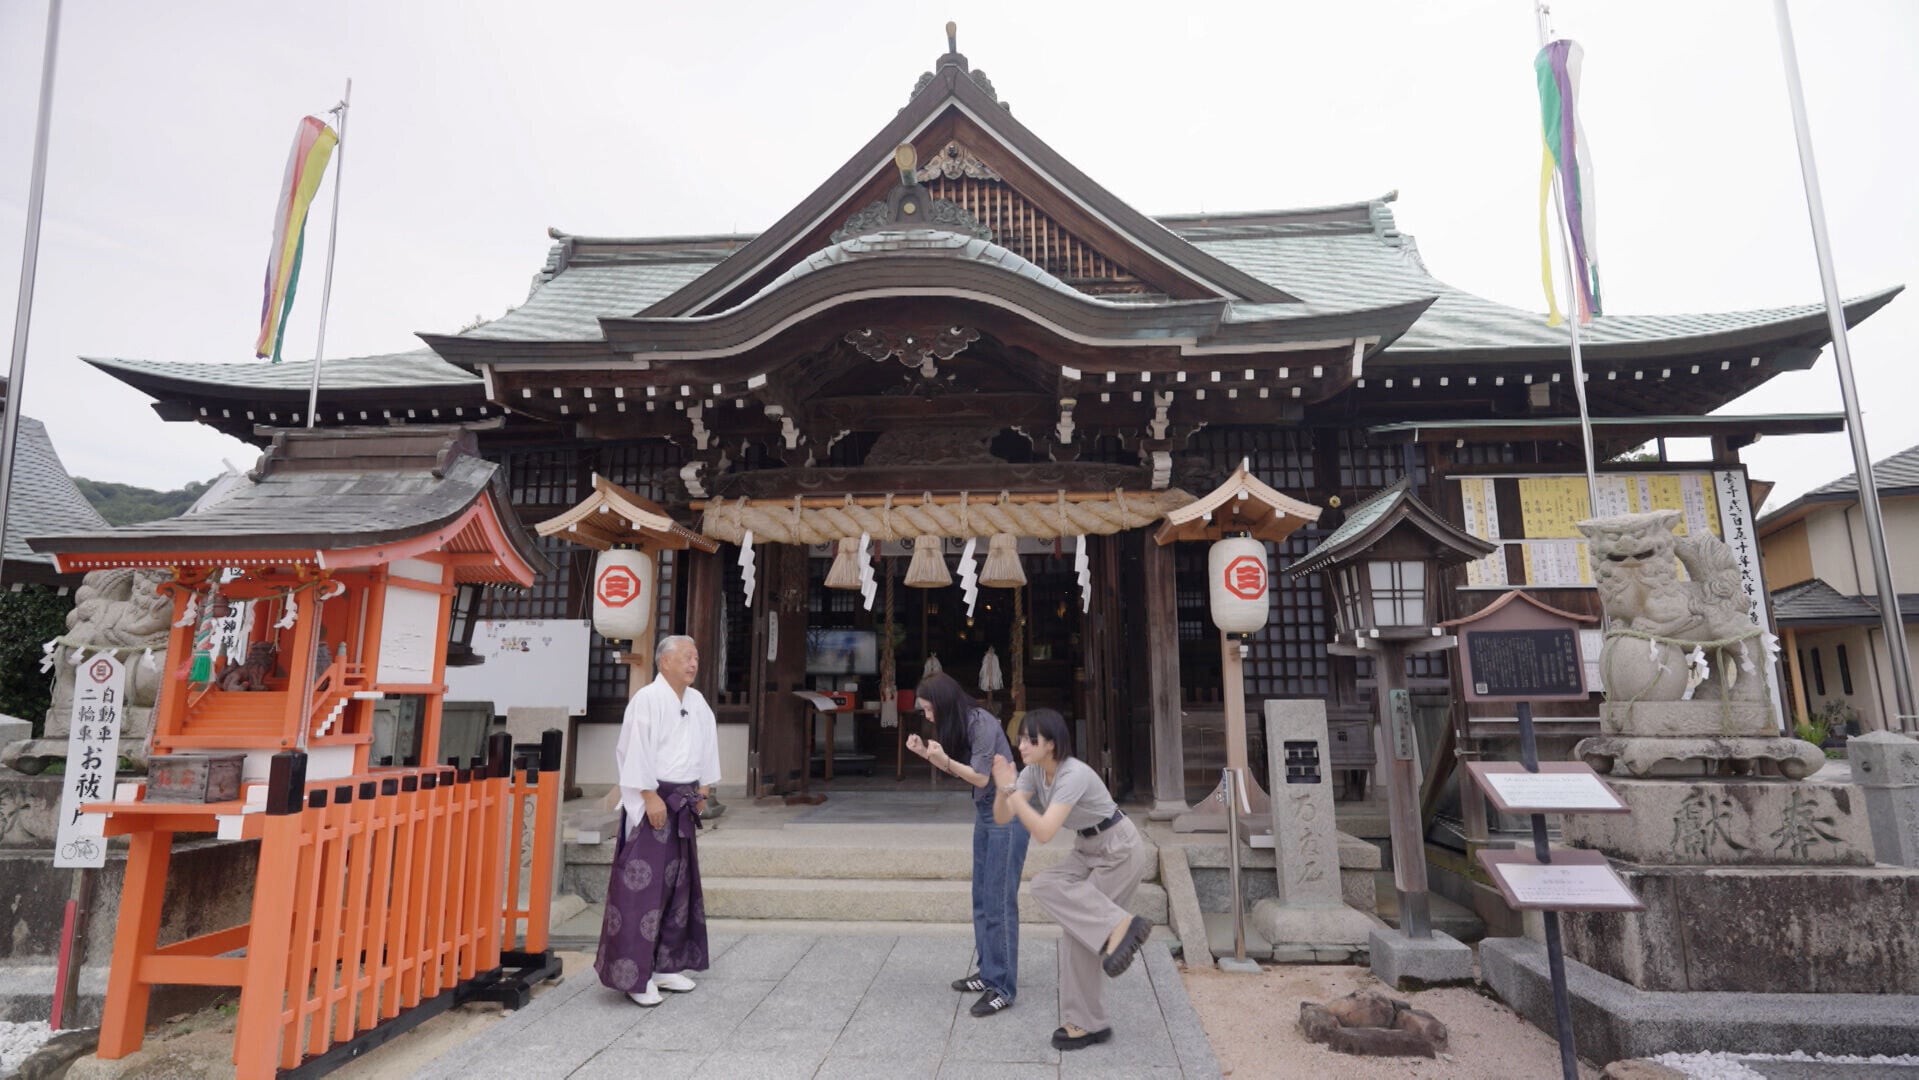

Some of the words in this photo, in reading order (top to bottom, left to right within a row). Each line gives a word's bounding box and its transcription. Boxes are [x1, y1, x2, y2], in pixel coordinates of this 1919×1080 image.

[77, 688, 98, 743] 二輪車
[98, 687, 116, 744] 自動車
